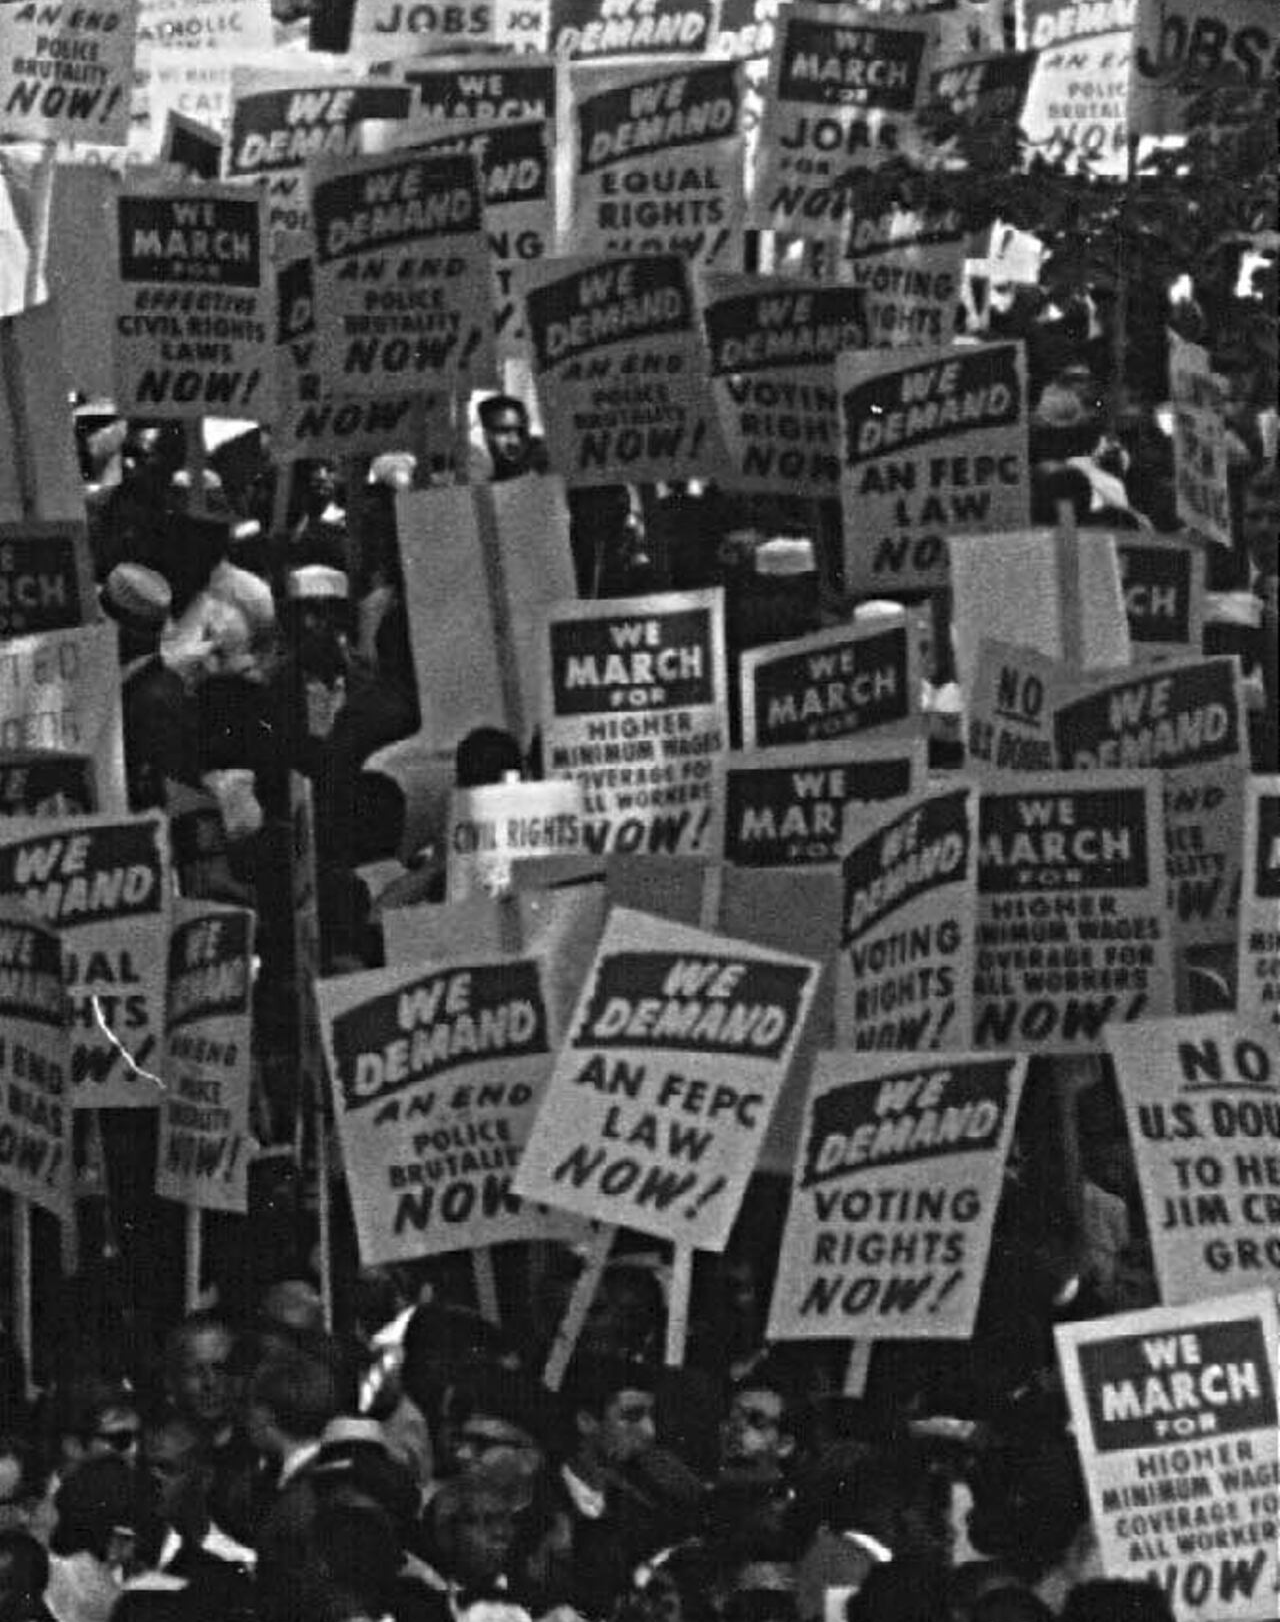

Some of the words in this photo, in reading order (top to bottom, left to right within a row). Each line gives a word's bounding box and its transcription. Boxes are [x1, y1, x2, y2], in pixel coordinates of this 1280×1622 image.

[15, 3, 57, 24] AN
[68, 8, 118, 31] END
[375, 2, 488, 33] JOBS
[37, 35, 99, 58] POLICE
[6, 88, 120, 123] NOW!
[861, 389, 1008, 449] DEMAND
[861, 463, 915, 493] AN
[930, 455, 1019, 485] FEPC
[897, 495, 989, 526] LAW
[565, 646, 703, 689] MARCH
[588, 712, 691, 741] HIGHER
[665, 961, 744, 997] WE
[595, 997, 785, 1045] DEMAND
[576, 1056, 645, 1098] AN
[659, 1077, 764, 1128] FEPC
[876, 1073, 950, 1112] WE
[603, 1106, 713, 1161] LAW
[816, 1101, 998, 1171] DEMAND
[553, 1145, 727, 1220] NOW!
[815, 1190, 980, 1222] VOTING
[815, 1233, 964, 1266] RIGHTS
[801, 1271, 963, 1315] NOW!
[1103, 1362, 1260, 1422] MARCH
[1139, 1440, 1253, 1478] HIGHER
[1103, 1478, 1210, 1512] MINIMUM
